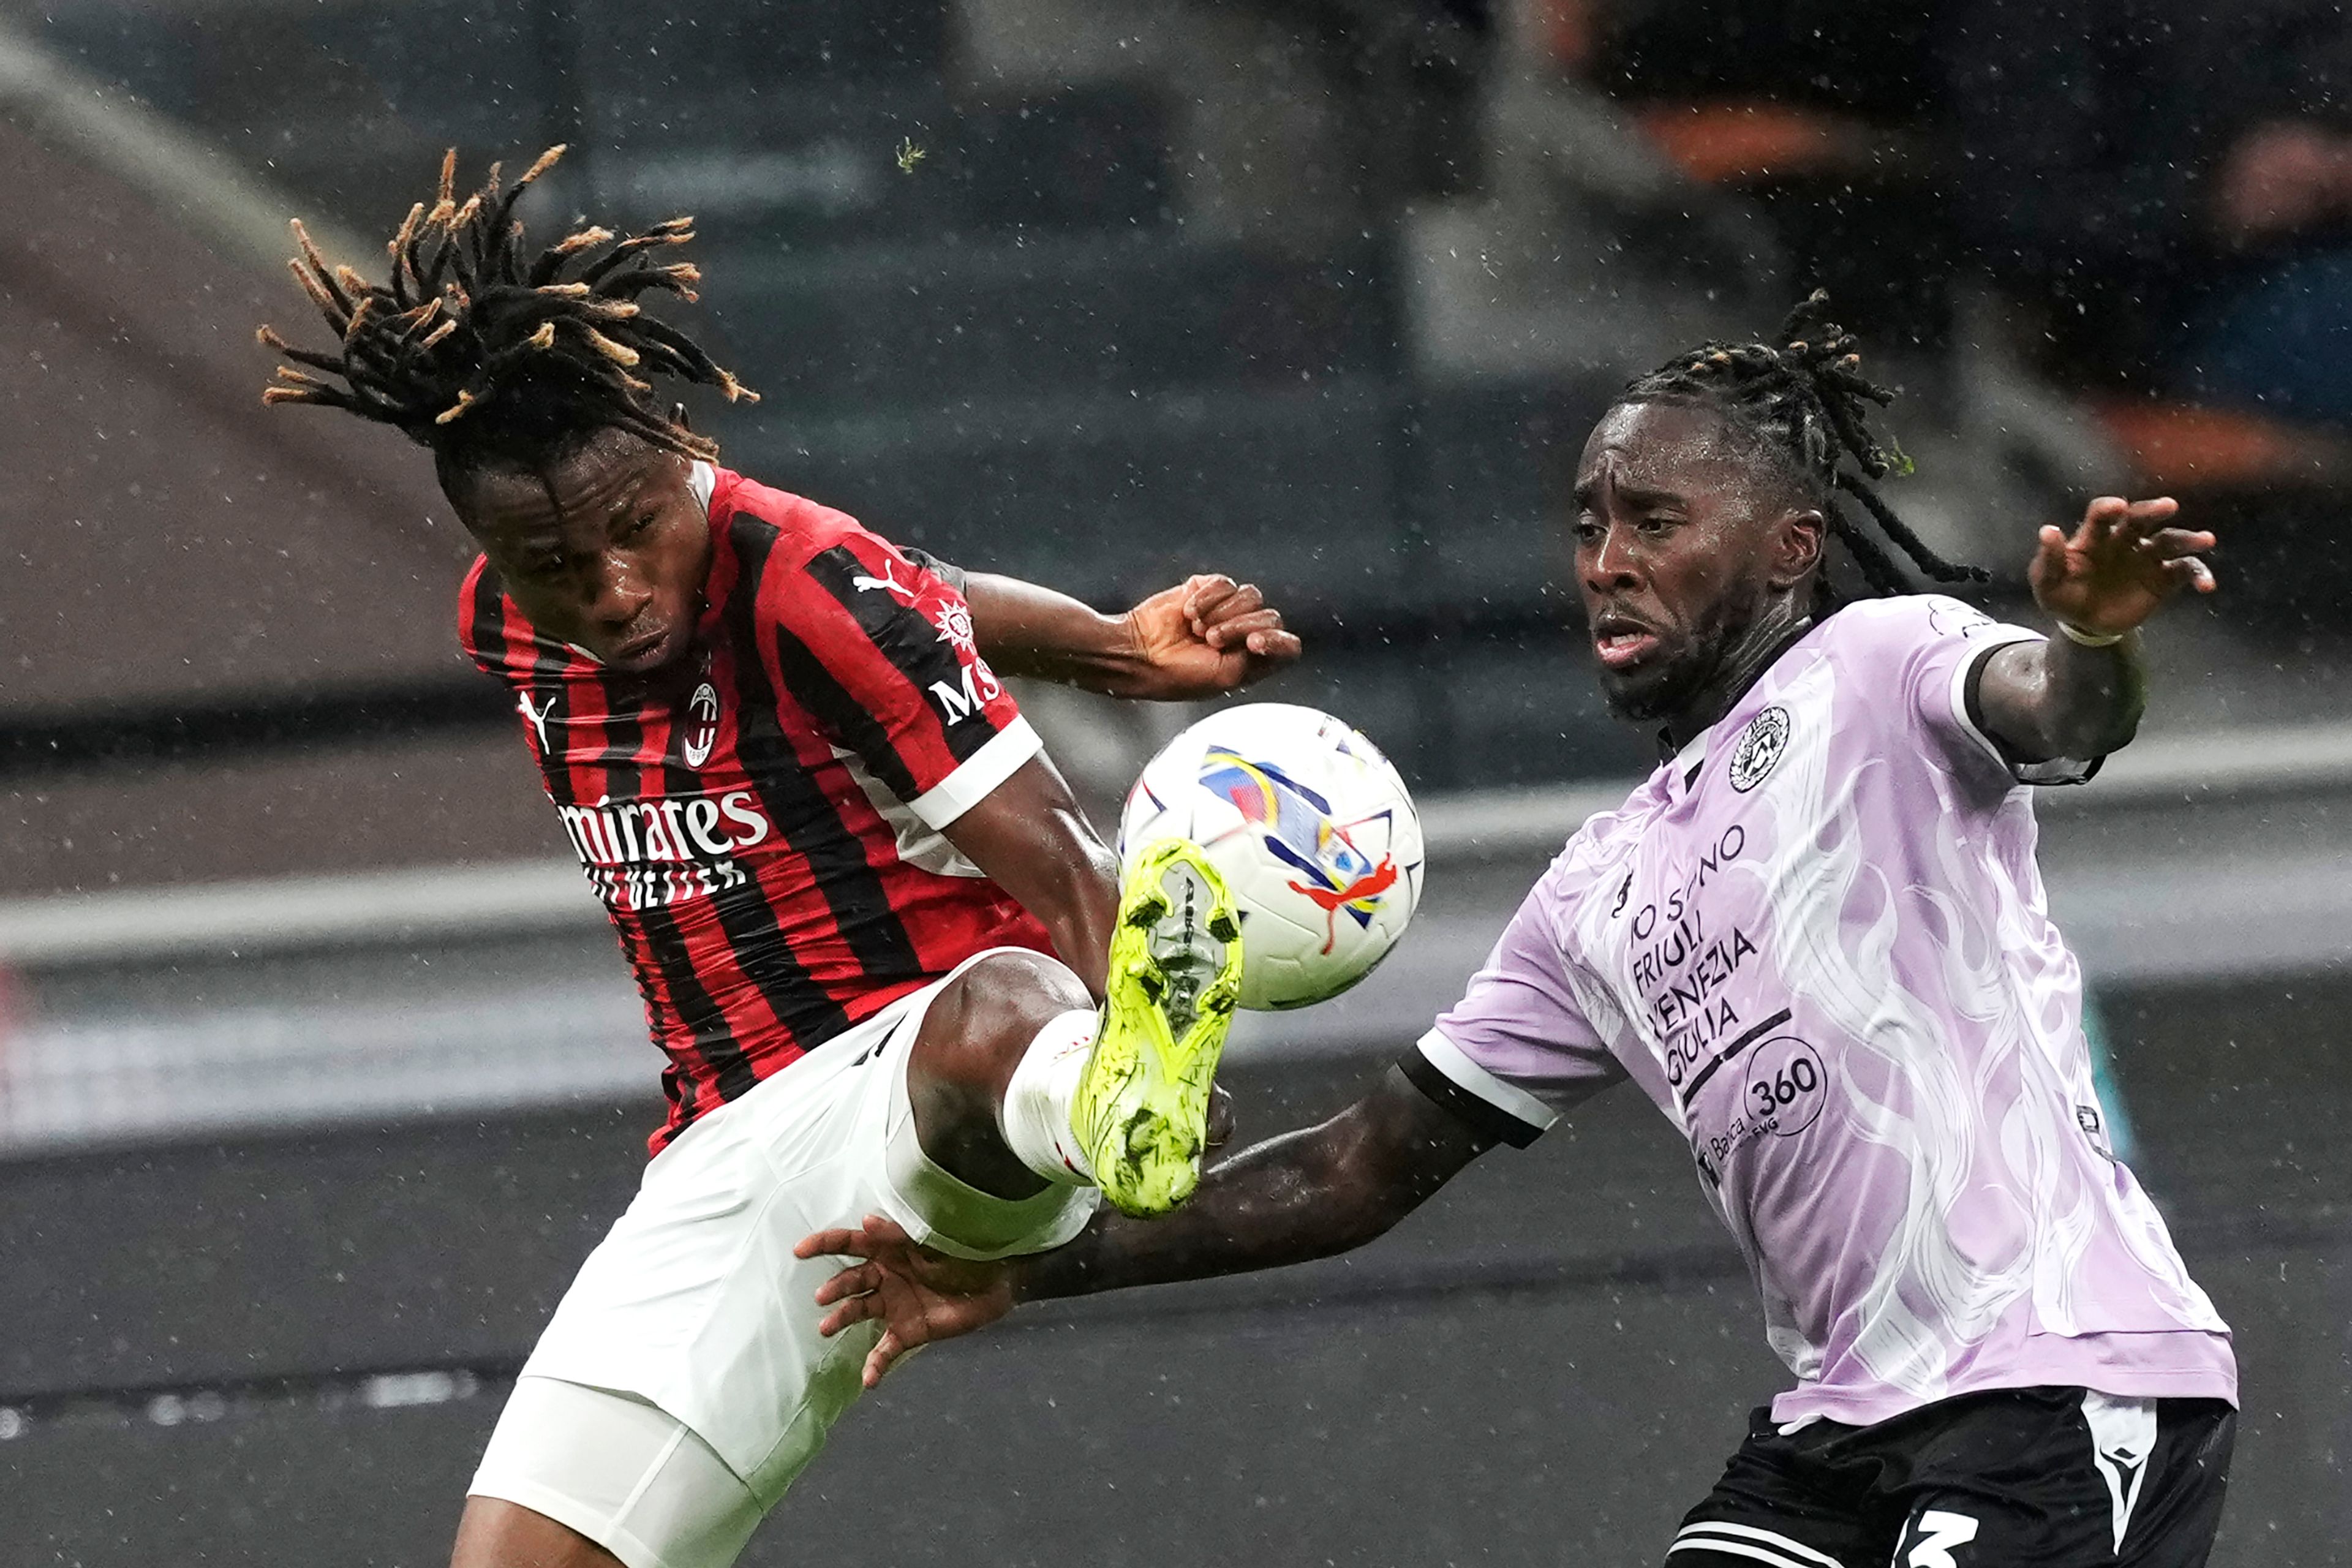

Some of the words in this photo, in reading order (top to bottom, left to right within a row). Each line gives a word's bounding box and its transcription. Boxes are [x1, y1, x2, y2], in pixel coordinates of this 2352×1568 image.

[688, 749, 706, 761] 1899
[547, 791, 769, 862] mirates
[1667, 824, 1745, 921] SNO
[1633, 910, 1703, 998] FRIULI
[1646, 926, 1758, 1040] VENEZIA
[1667, 996, 1740, 1086] GIULIA
[1752, 1058, 1817, 1116] 360
[1751, 1117, 1779, 1138] FVG
